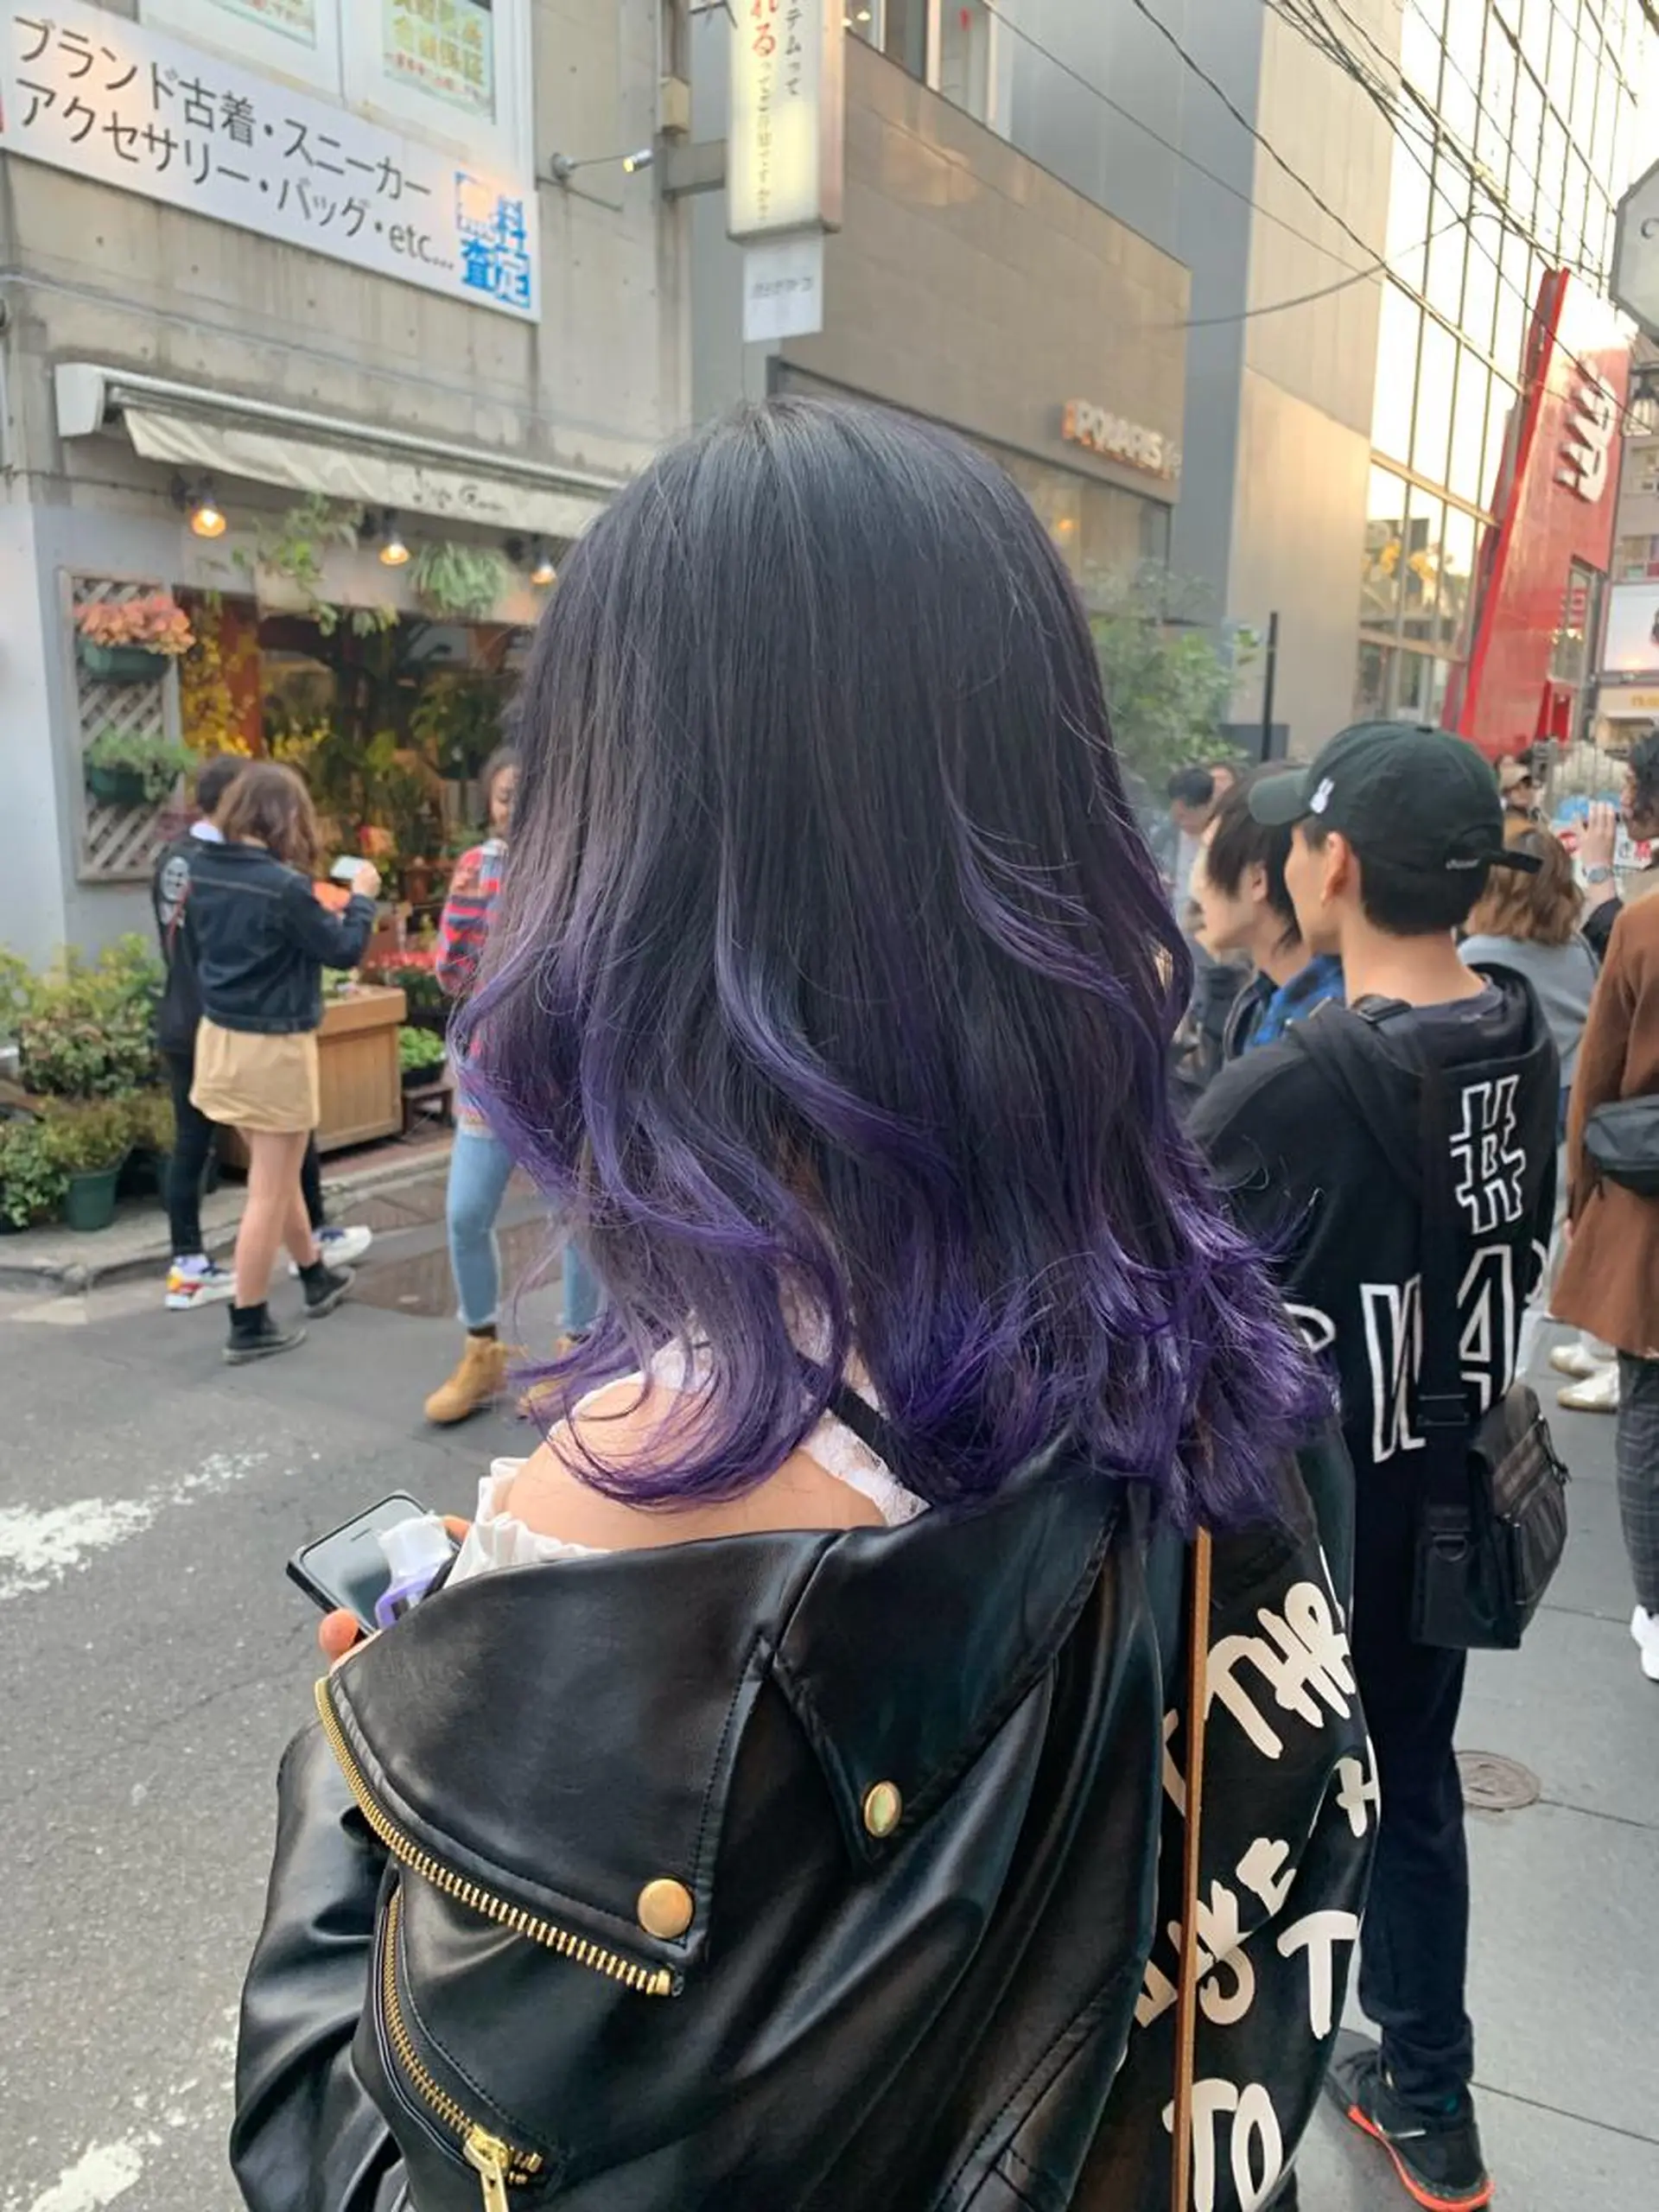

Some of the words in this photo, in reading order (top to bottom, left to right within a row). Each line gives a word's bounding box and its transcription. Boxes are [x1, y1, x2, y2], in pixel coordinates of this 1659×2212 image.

[14, 16, 431, 197] ブランド古着・スニーカー
